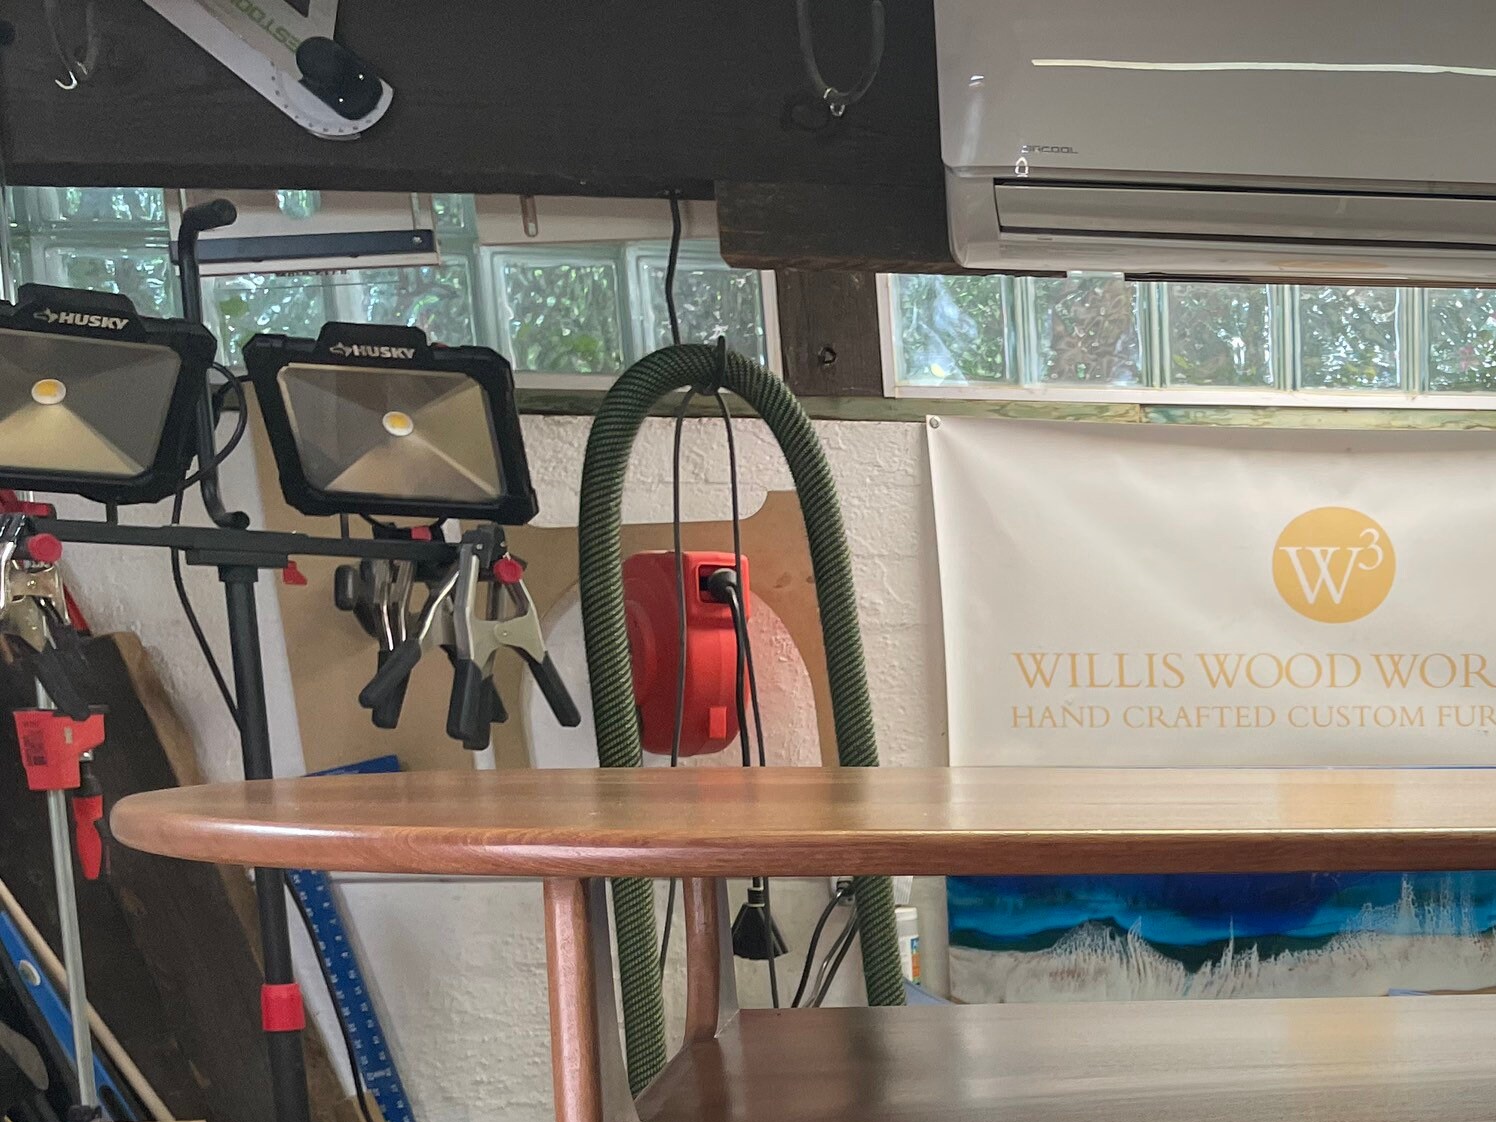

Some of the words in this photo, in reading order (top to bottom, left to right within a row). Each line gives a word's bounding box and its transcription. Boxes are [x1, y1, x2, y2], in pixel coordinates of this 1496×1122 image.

[58, 311, 129, 330] HUSKY
[352, 344, 415, 359] HUSKY
[1011, 652, 1185, 688] WILLIS
[1195, 652, 1362, 688] WOOD
[1010, 704, 1111, 729] HAND
[1122, 704, 1276, 729] CRAFTED
[1287, 705, 1425, 728] CUSTOM
